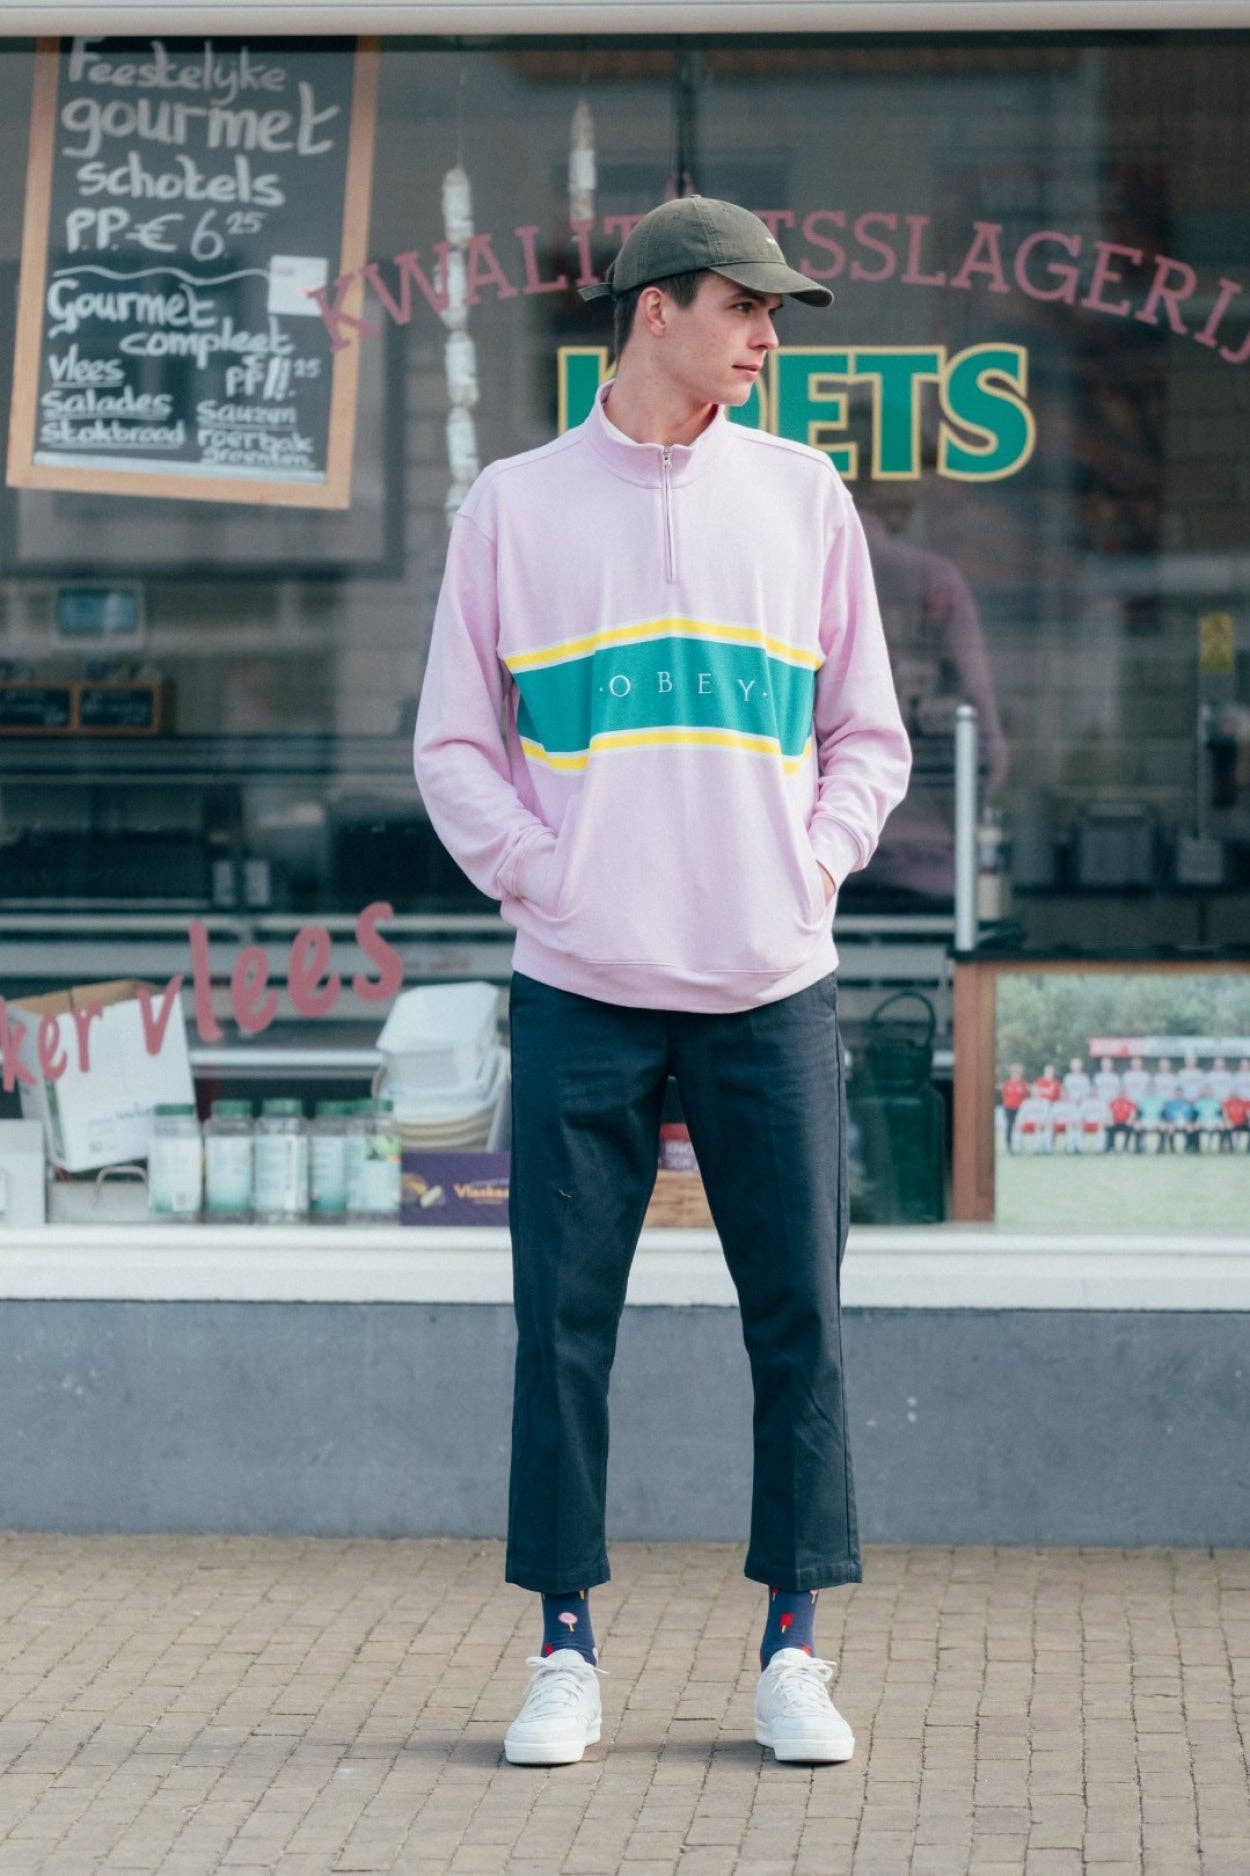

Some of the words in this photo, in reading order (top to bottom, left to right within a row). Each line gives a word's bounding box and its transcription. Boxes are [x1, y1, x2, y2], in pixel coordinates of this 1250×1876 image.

[61, 81, 340, 158] gourmet
[77, 150, 286, 207] schotels
[40, 385, 174, 418] Salades
[557, 342, 1038, 482] ETS
[608, 671, 756, 702] OBEY
[137, 901, 404, 1056] vlees
